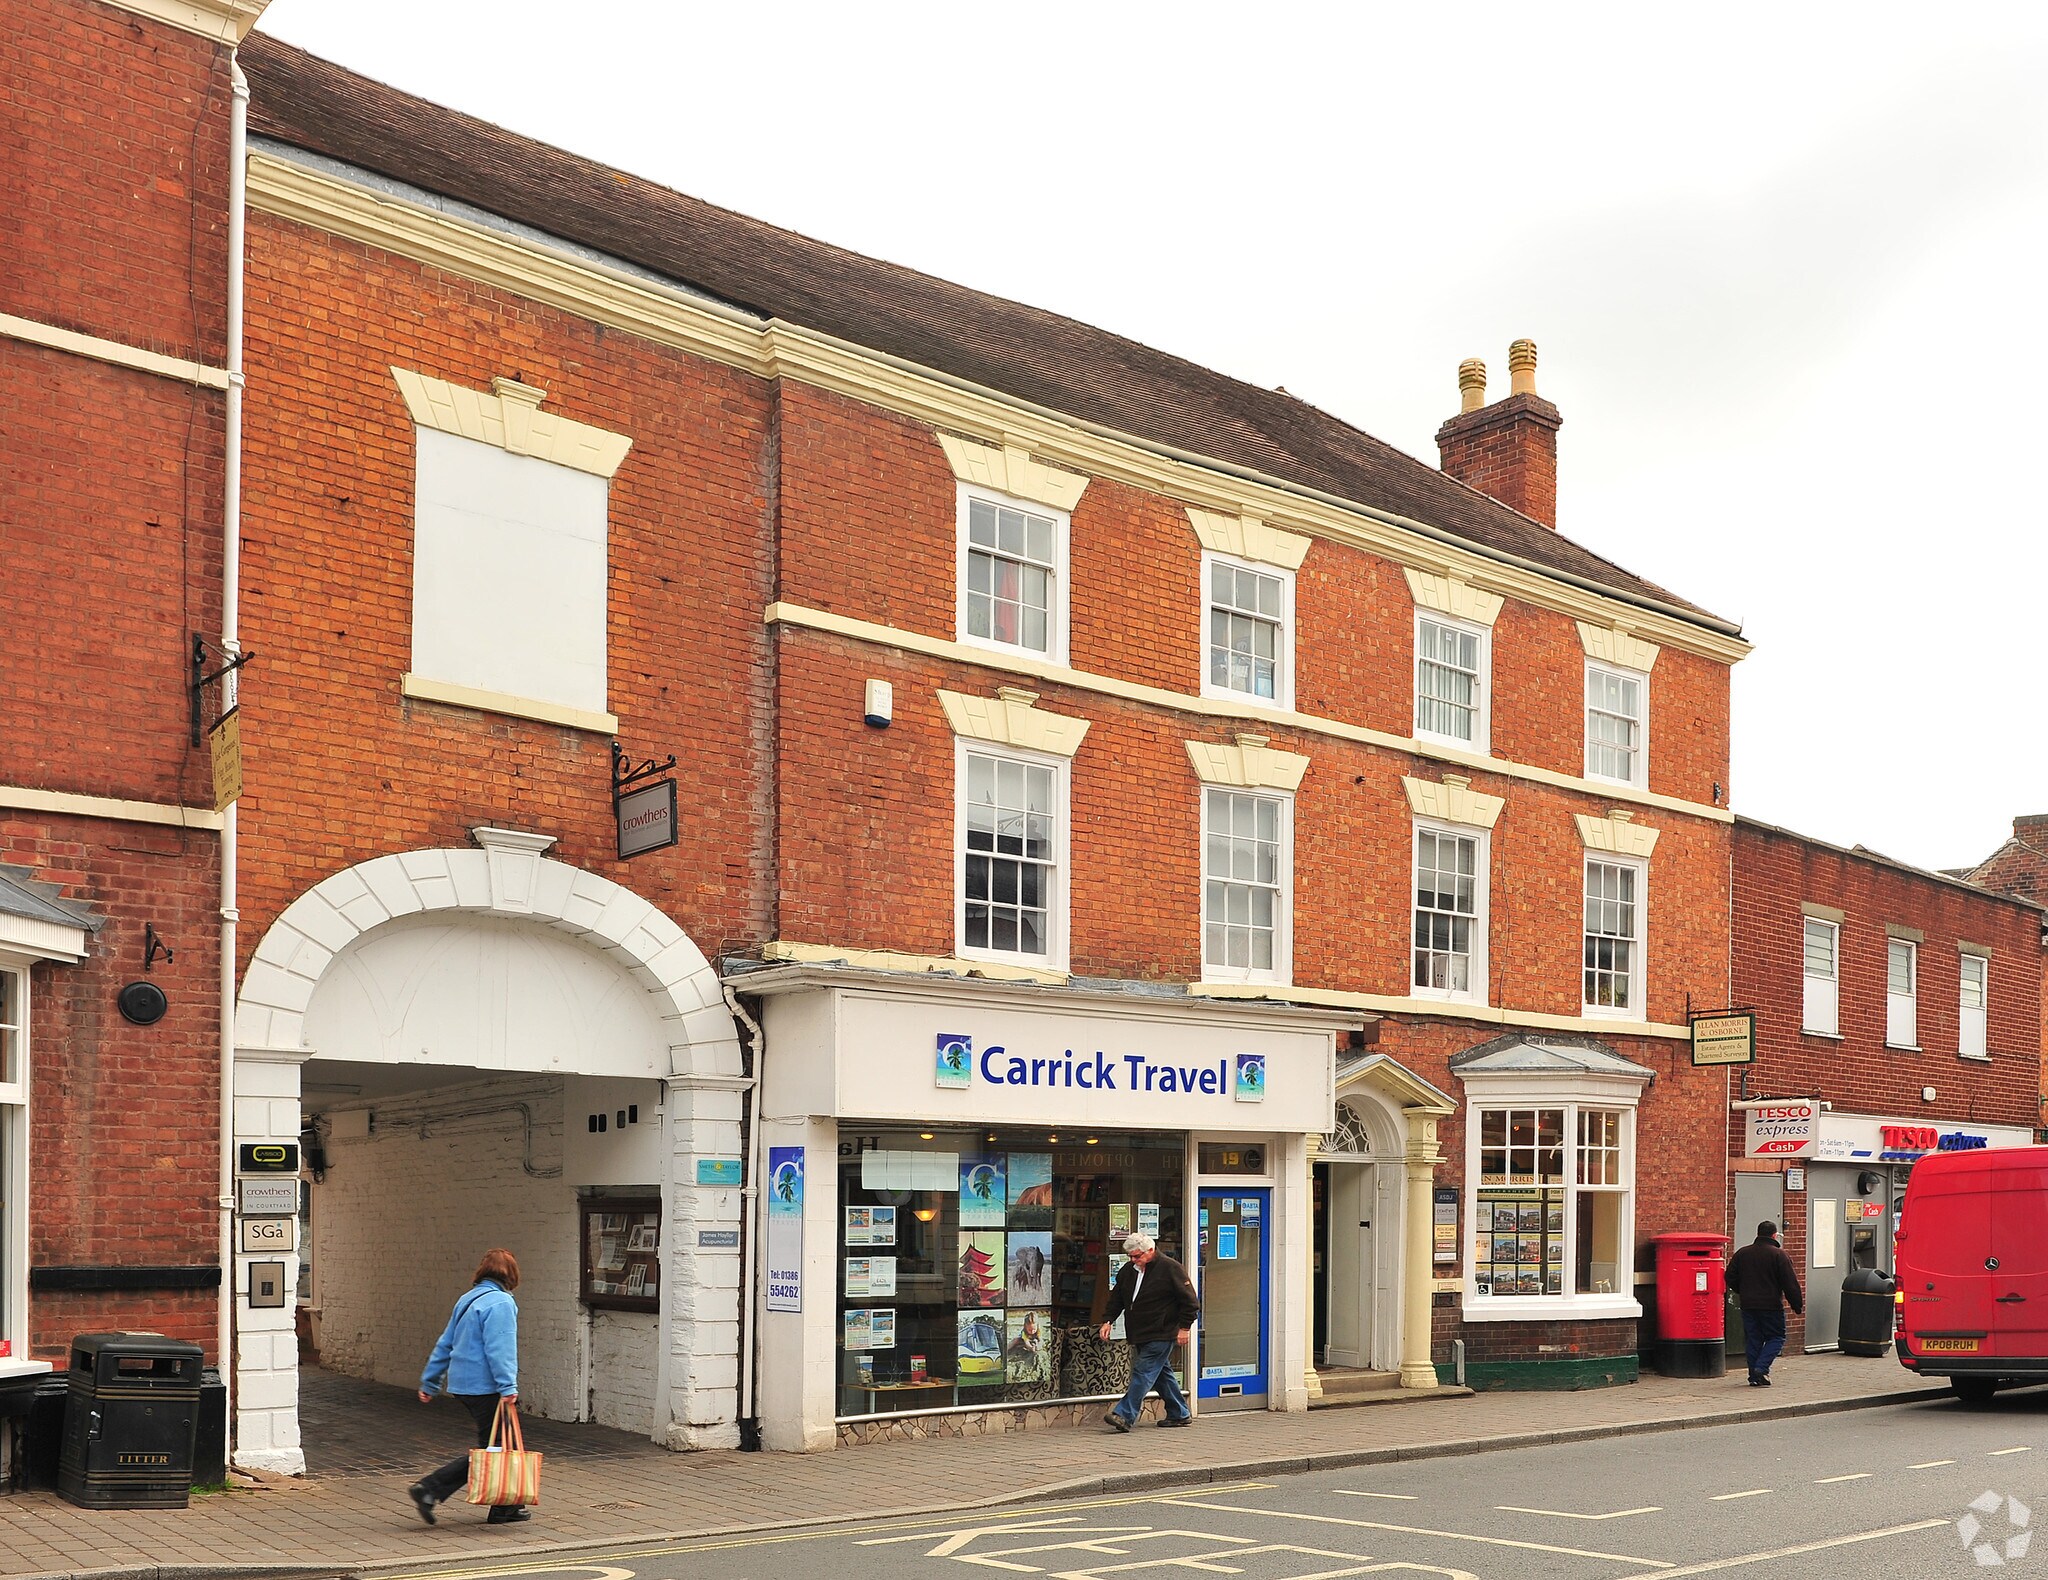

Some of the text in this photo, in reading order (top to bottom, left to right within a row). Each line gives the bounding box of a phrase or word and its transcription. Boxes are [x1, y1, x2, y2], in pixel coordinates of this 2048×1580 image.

[623, 807, 668, 831] crowthers
[1697, 1019, 1748, 1029] ALLAN MORRIS
[1709, 1027, 1744, 1036] OSBORNE
[980, 1046, 1227, 1095] Carrick Travel
[1755, 1107, 1811, 1118] TESCO
[1756, 1125, 1809, 1138] express
[1880, 1126, 1938, 1149] TESCO
[1768, 1142, 1795, 1152] Cash
[1223, 1151, 1239, 1165] 19
[246, 1188, 291, 1196] crowthers
[252, 1224, 284, 1238] SGa
[770, 1270, 798, 1281] Tel: 01386
[770, 1284, 799, 1299] 554262
[119, 1455, 168, 1463] LITTER
